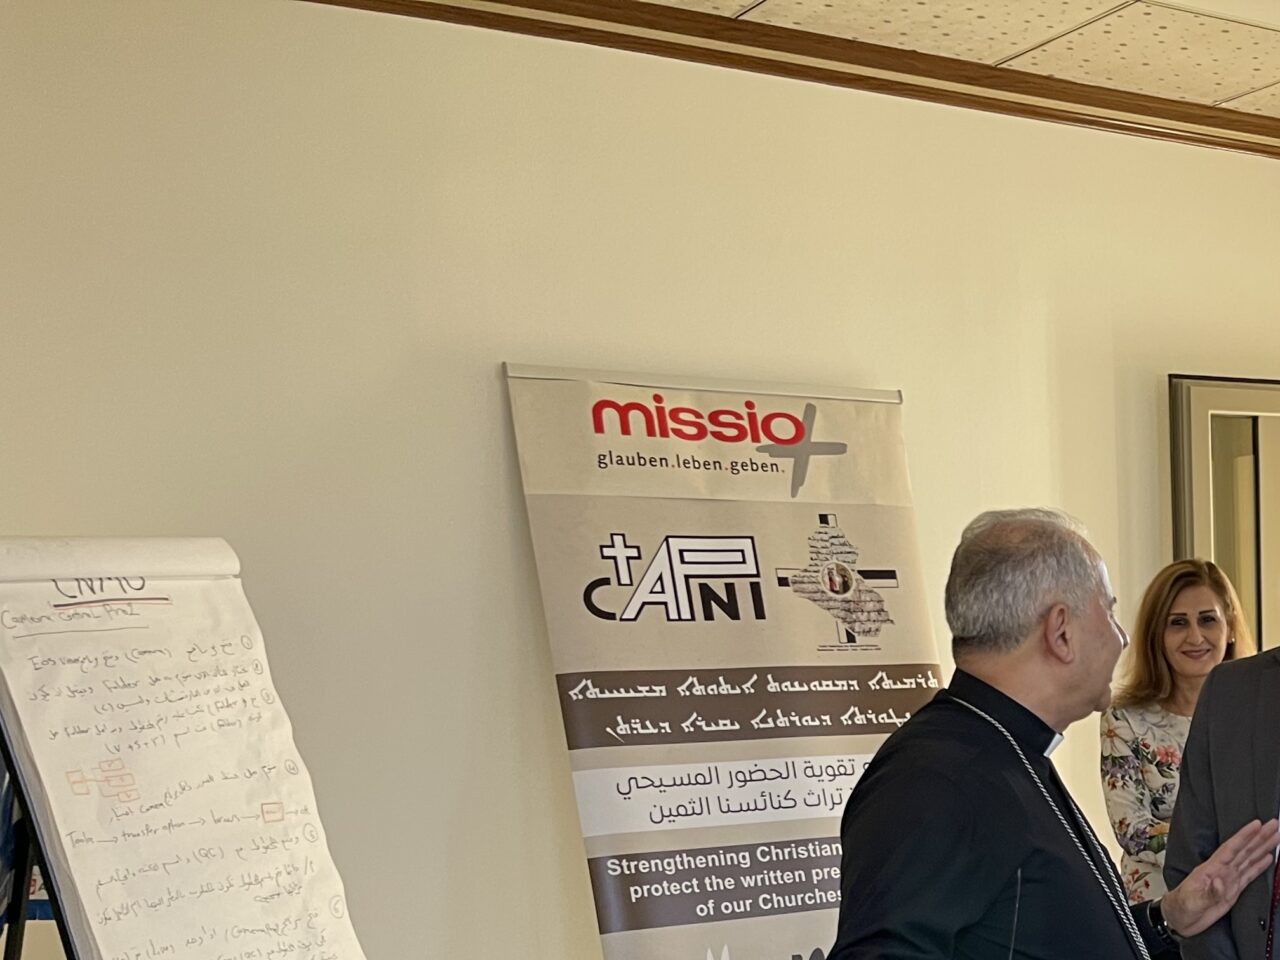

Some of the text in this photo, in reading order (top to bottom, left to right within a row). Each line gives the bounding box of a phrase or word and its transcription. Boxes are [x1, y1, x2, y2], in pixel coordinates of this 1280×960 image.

[591, 392, 807, 447] missio
[596, 450, 786, 476] glauben.leben.geben.
[616, 765, 720, 800] المسيحي
[727, 760, 797, 789] الحضور
[803, 758, 856, 783] تقوية
[649, 787, 844, 824] تراث كنائسنا الثمين
[606, 841, 843, 876] Strengthening Christian
[629, 877, 700, 903] protect
[704, 875, 736, 892] the
[740, 867, 806, 889] written
[696, 900, 715, 917] of
[720, 898, 752, 914] our
